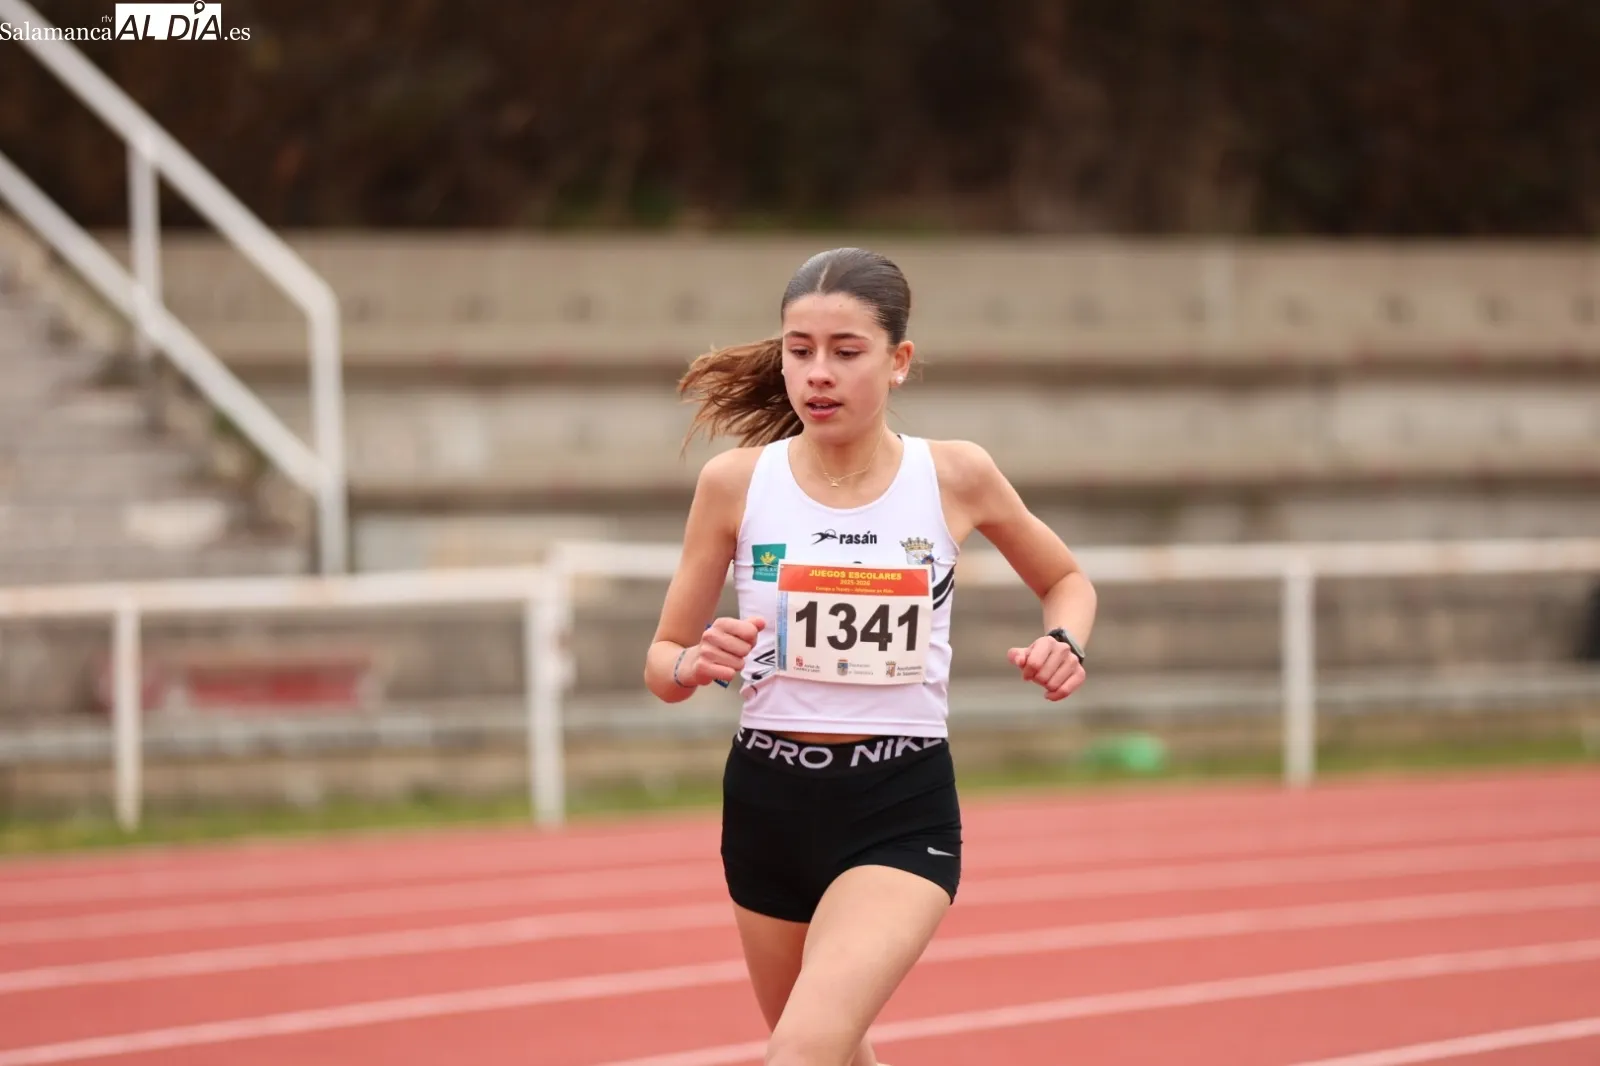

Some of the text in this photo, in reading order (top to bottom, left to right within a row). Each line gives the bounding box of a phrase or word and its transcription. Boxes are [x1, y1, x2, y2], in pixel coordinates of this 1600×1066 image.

[839, 531, 878, 545] rasán
[809, 569, 902, 580] JUEGOS ESCOLARES
[796, 601, 919, 651] 1341
[746, 730, 834, 769] PRO
